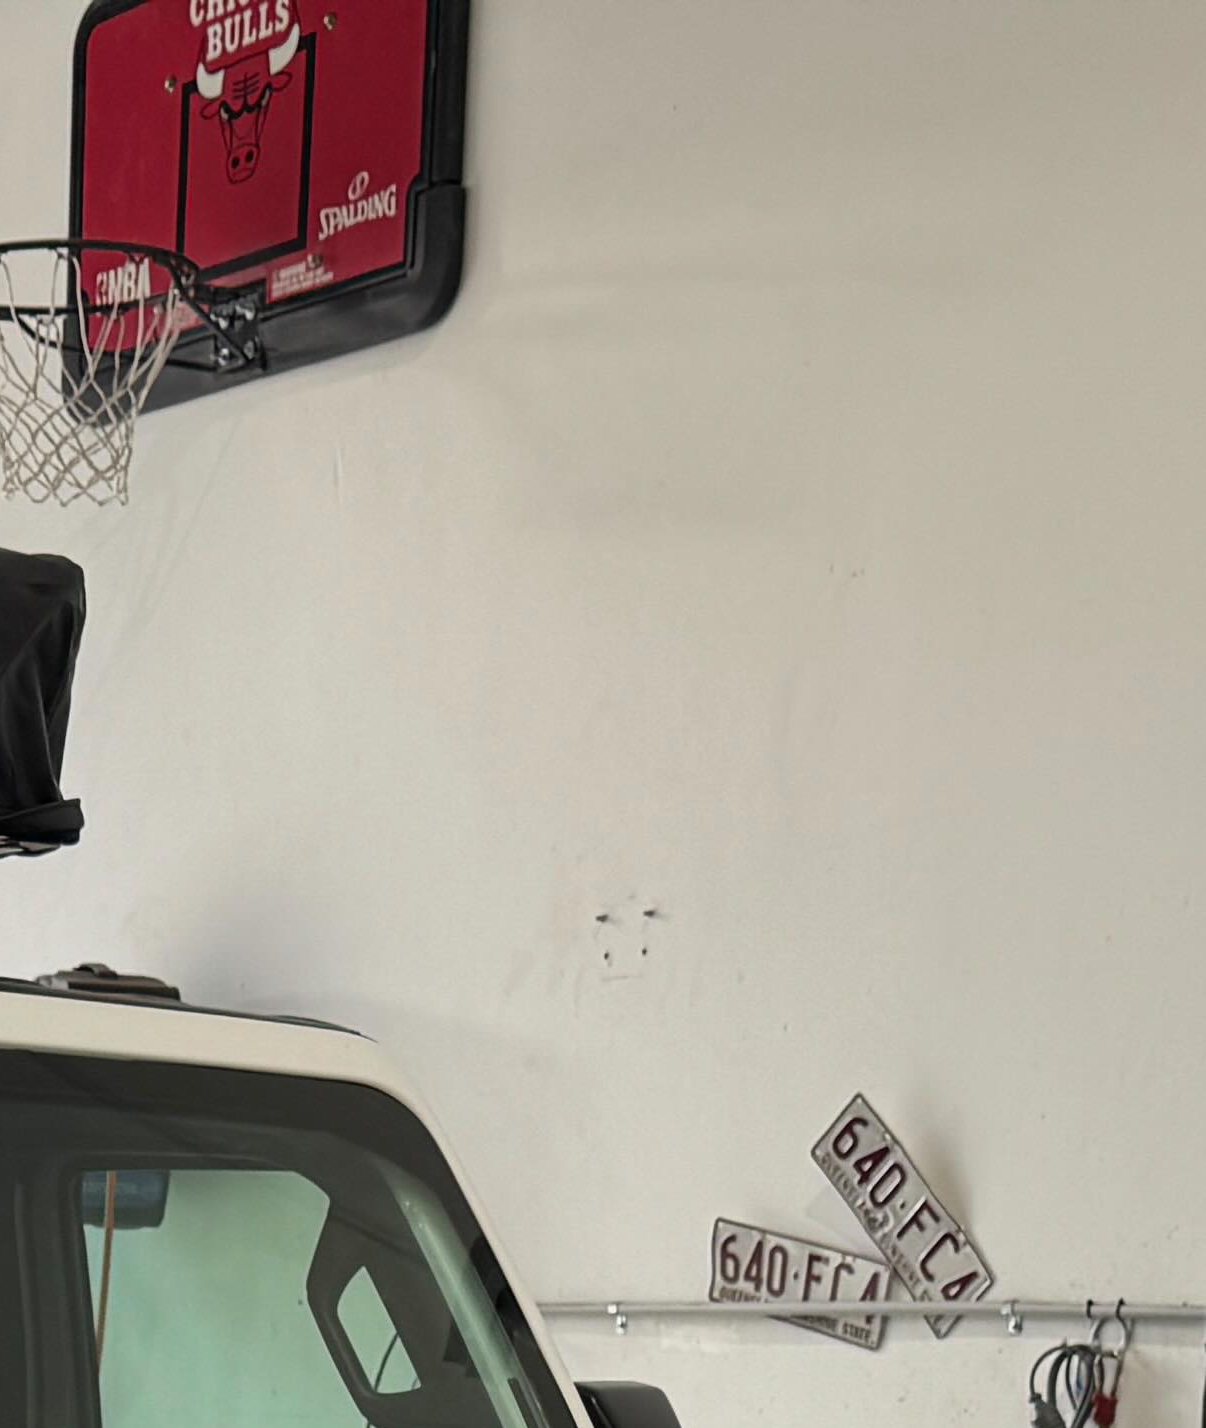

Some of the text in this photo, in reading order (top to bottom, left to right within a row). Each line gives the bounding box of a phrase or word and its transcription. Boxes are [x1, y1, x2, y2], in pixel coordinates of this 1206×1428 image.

[206, 0, 290, 63] BULLS
[318, 184, 396, 241] SPALDING
[108, 258, 150, 305] NBA
